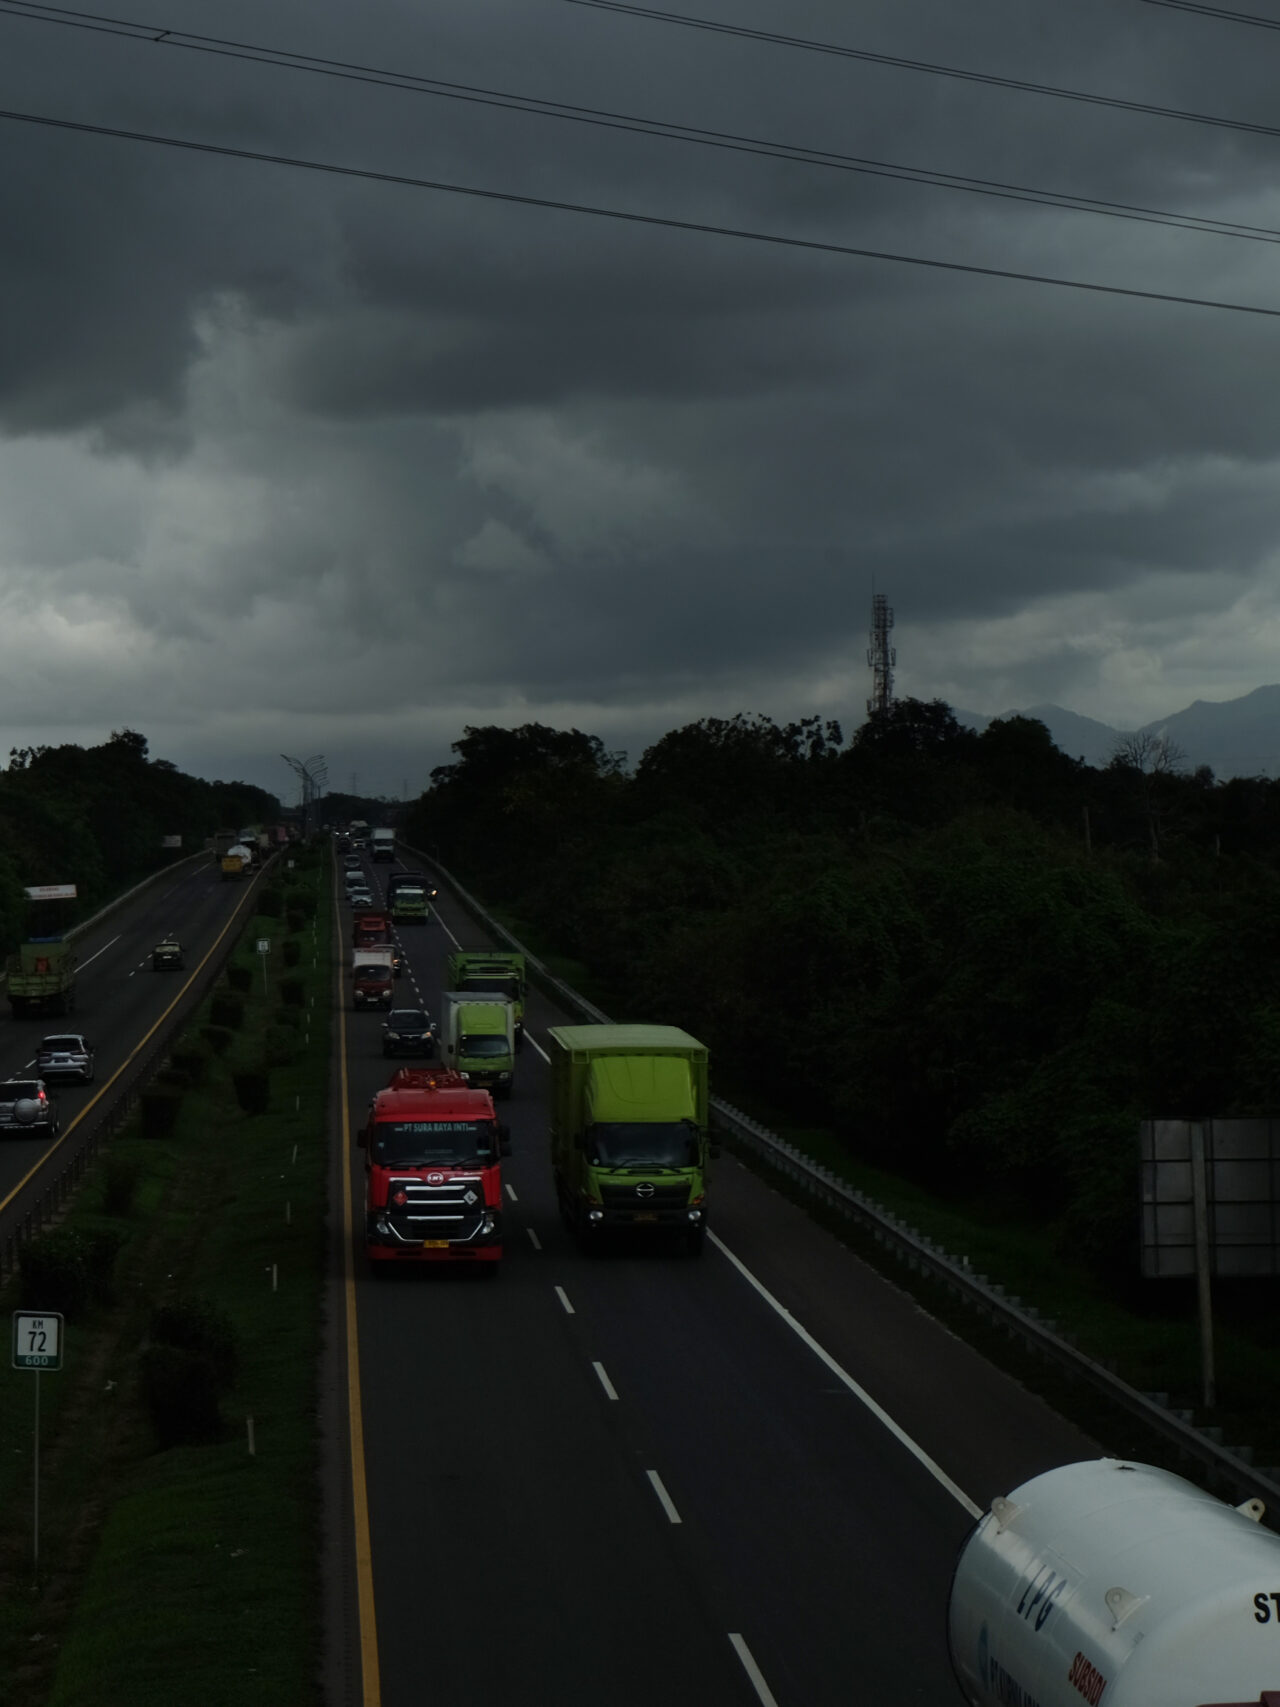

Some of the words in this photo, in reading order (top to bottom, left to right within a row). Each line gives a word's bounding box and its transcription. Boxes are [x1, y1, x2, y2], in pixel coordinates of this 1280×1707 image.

[403, 1123, 412, 1133] PT
[32, 1319, 44, 1329] KM
[28, 1331, 47, 1352] 72
[25, 1356, 48, 1366] 600
[1017, 1564, 1067, 1632] LPG
[1069, 1651, 1107, 1707] SUBSIDI
